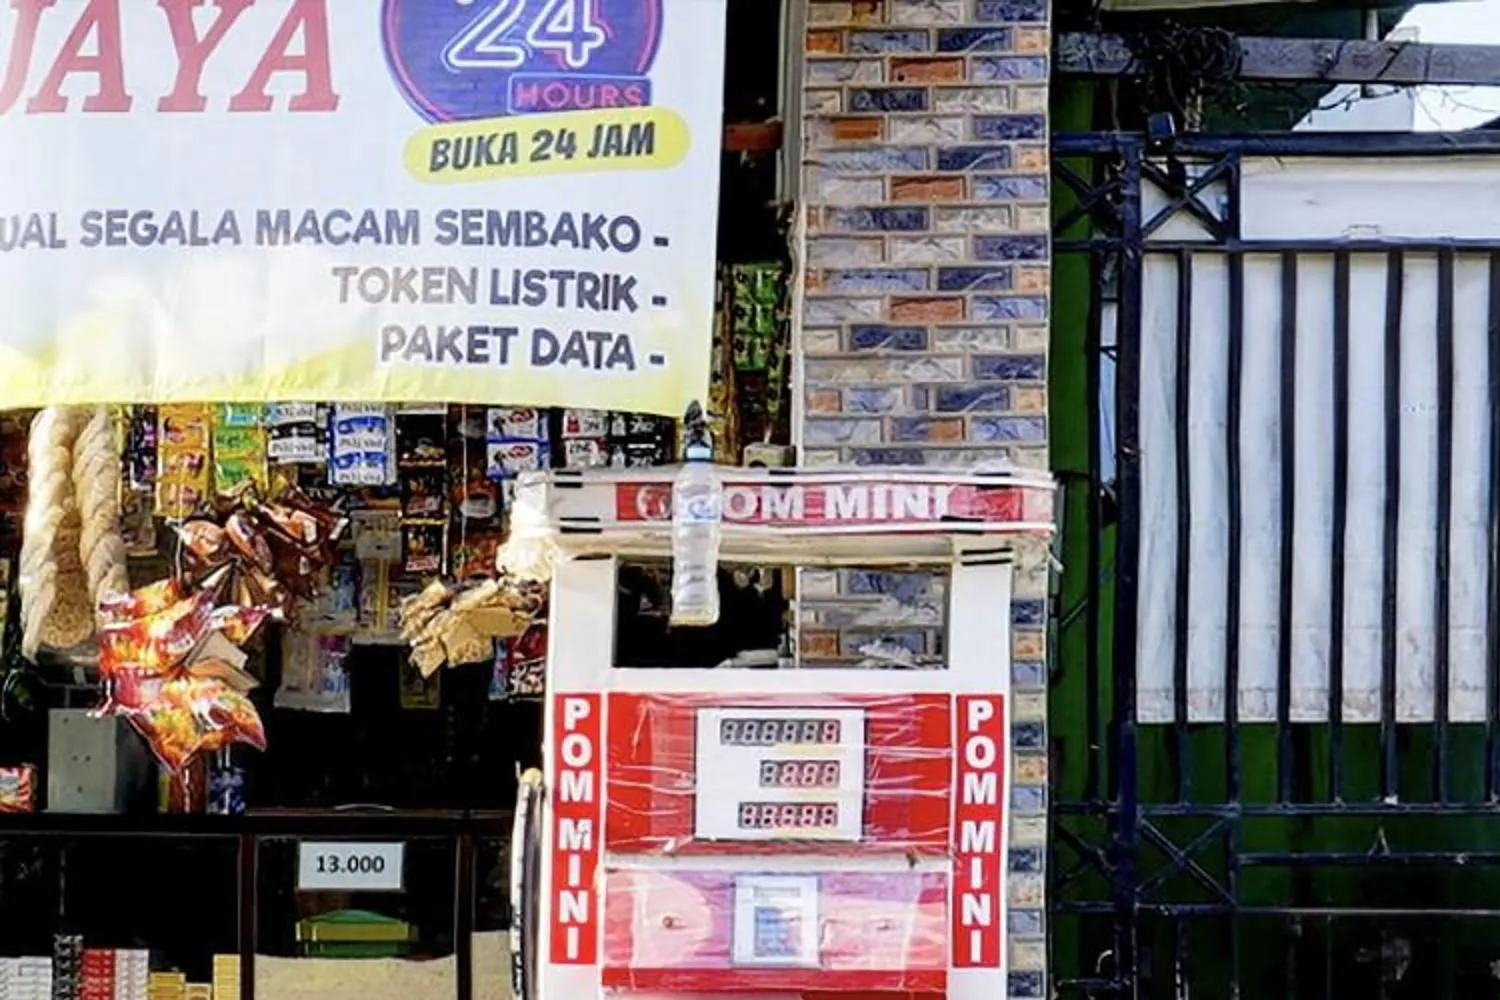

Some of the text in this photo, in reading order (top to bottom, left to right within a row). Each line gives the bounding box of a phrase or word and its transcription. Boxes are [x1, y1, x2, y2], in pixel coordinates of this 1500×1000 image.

[0, 0, 341, 115] JAYA
[447, 0, 605, 69] 24
[515, 81, 643, 109] HOURS
[429, 120, 656, 173] BUKA 24 JAM
[79, 209, 242, 247] SEGALA
[255, 209, 420, 246] MACAM
[434, 209, 642, 252] SEMBAKO
[331, 266, 478, 305] TOKEN
[489, 268, 639, 313] LISTRIK
[380, 325, 519, 366] PAKET
[530, 328, 637, 372] DATA
[720, 483, 956, 521] OM MINI
[558, 697, 594, 960] POM MINI
[960, 698, 998, 963] POM MINI
[316, 854, 385, 874] 13.000
